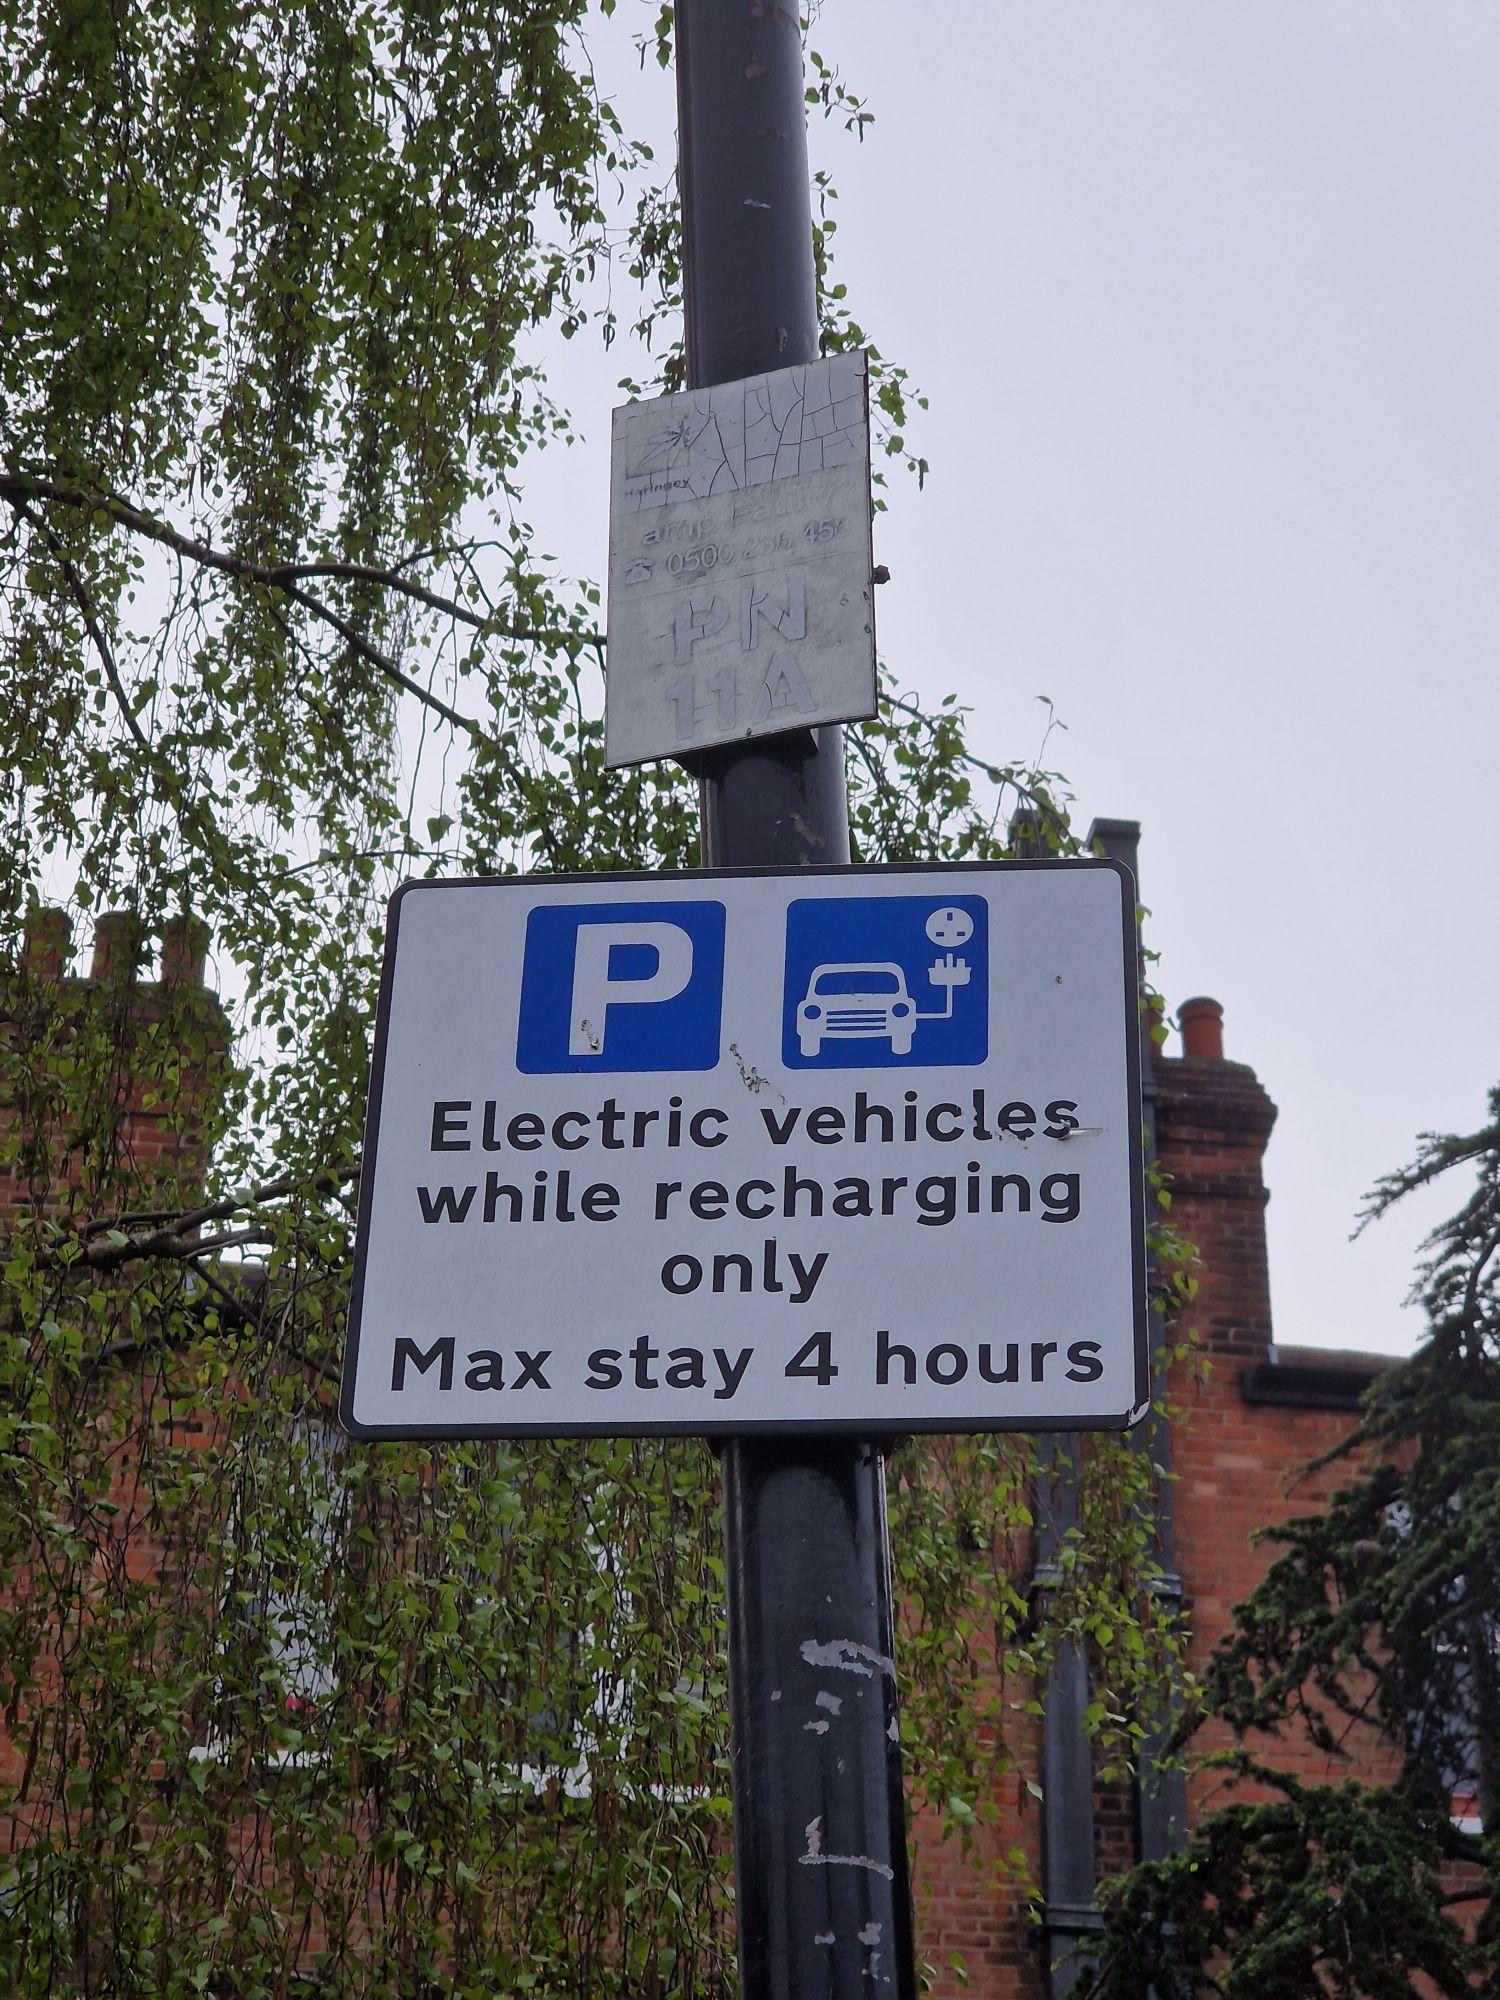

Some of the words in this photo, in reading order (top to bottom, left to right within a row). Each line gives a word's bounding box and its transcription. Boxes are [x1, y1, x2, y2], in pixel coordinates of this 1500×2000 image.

[569, 922, 693, 1055] P
[431, 1096, 729, 1151] Electric
[760, 1089, 1079, 1144] vehicles
[417, 1170, 620, 1223] while
[655, 1161, 1080, 1226] recharging
[661, 1239, 829, 1303] only
[391, 1337, 552, 1391] Max
[584, 1335, 754, 1399] stay
[785, 1332, 838, 1385] 4
[876, 1331, 1103, 1385] hours
